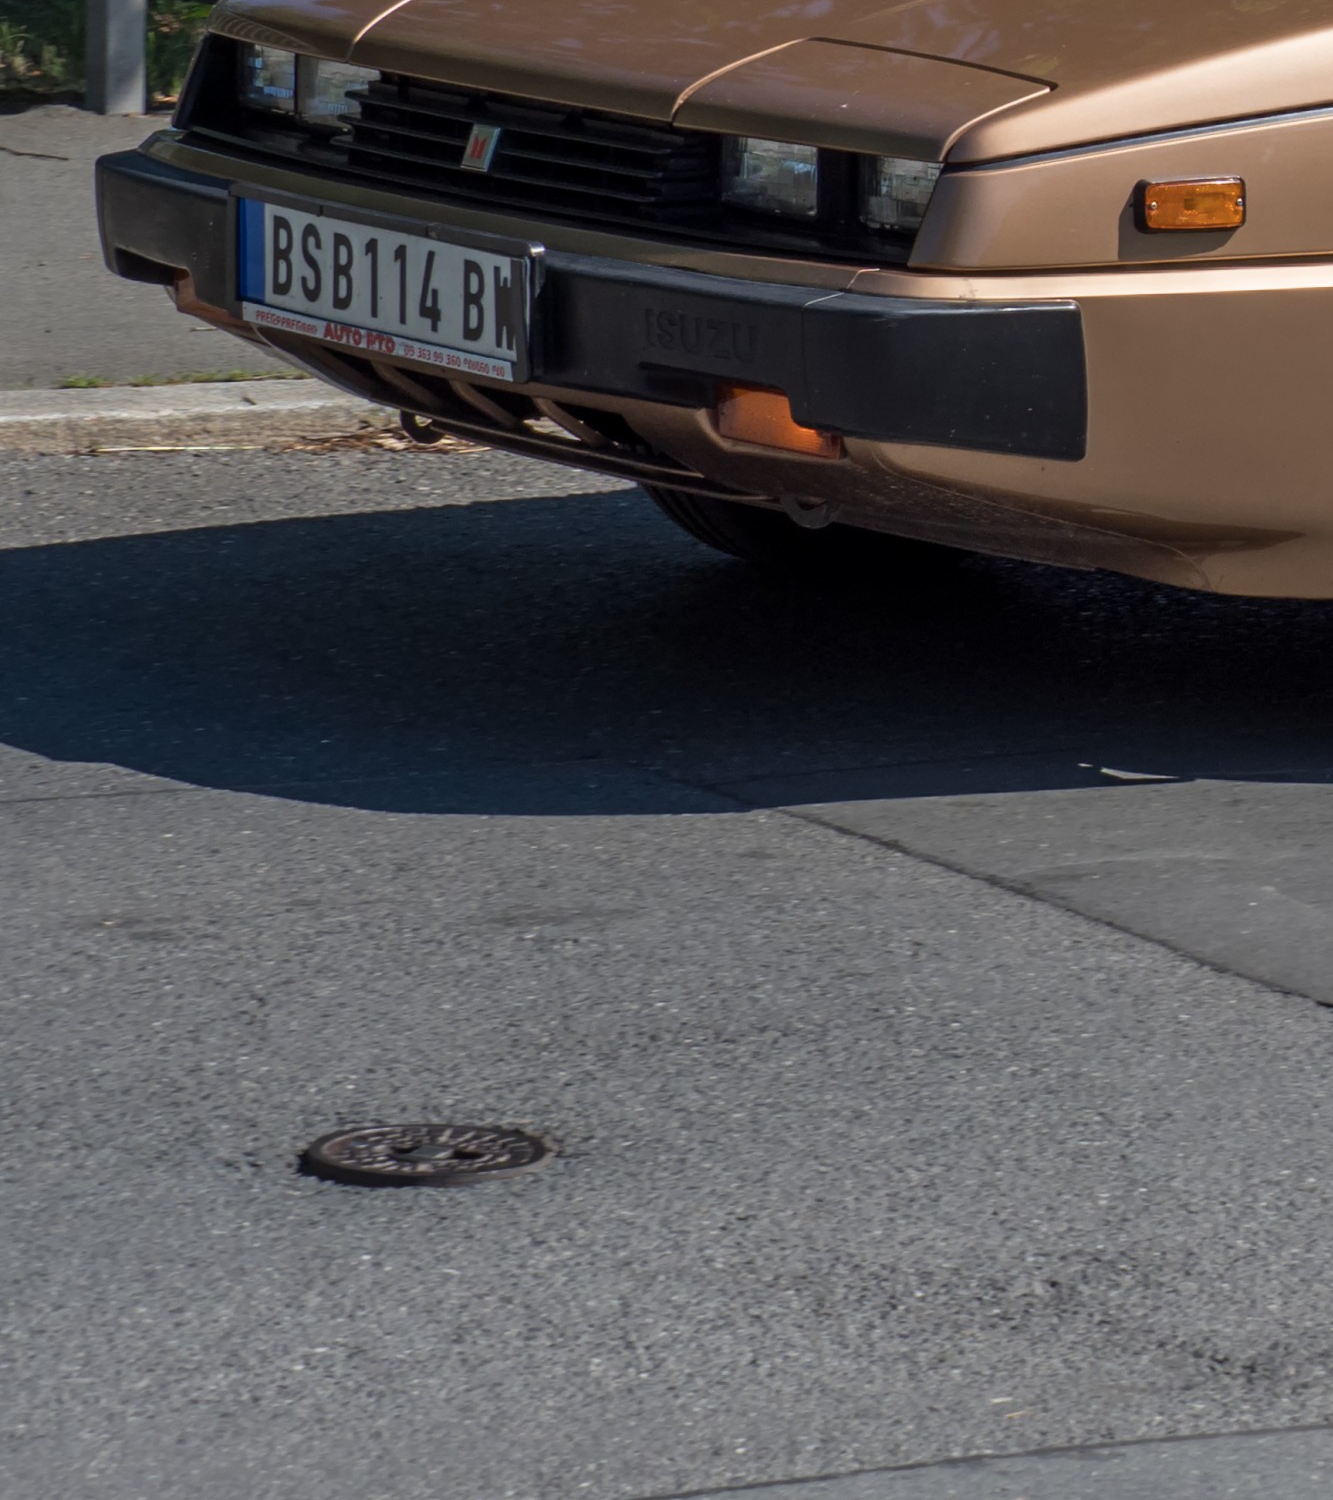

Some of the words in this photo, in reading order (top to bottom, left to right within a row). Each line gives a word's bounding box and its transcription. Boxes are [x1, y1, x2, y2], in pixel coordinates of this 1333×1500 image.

[272, 215, 442, 332] BSB114
[324, 322, 362, 346] AUTO
[644, 308, 759, 364] ISUZU
